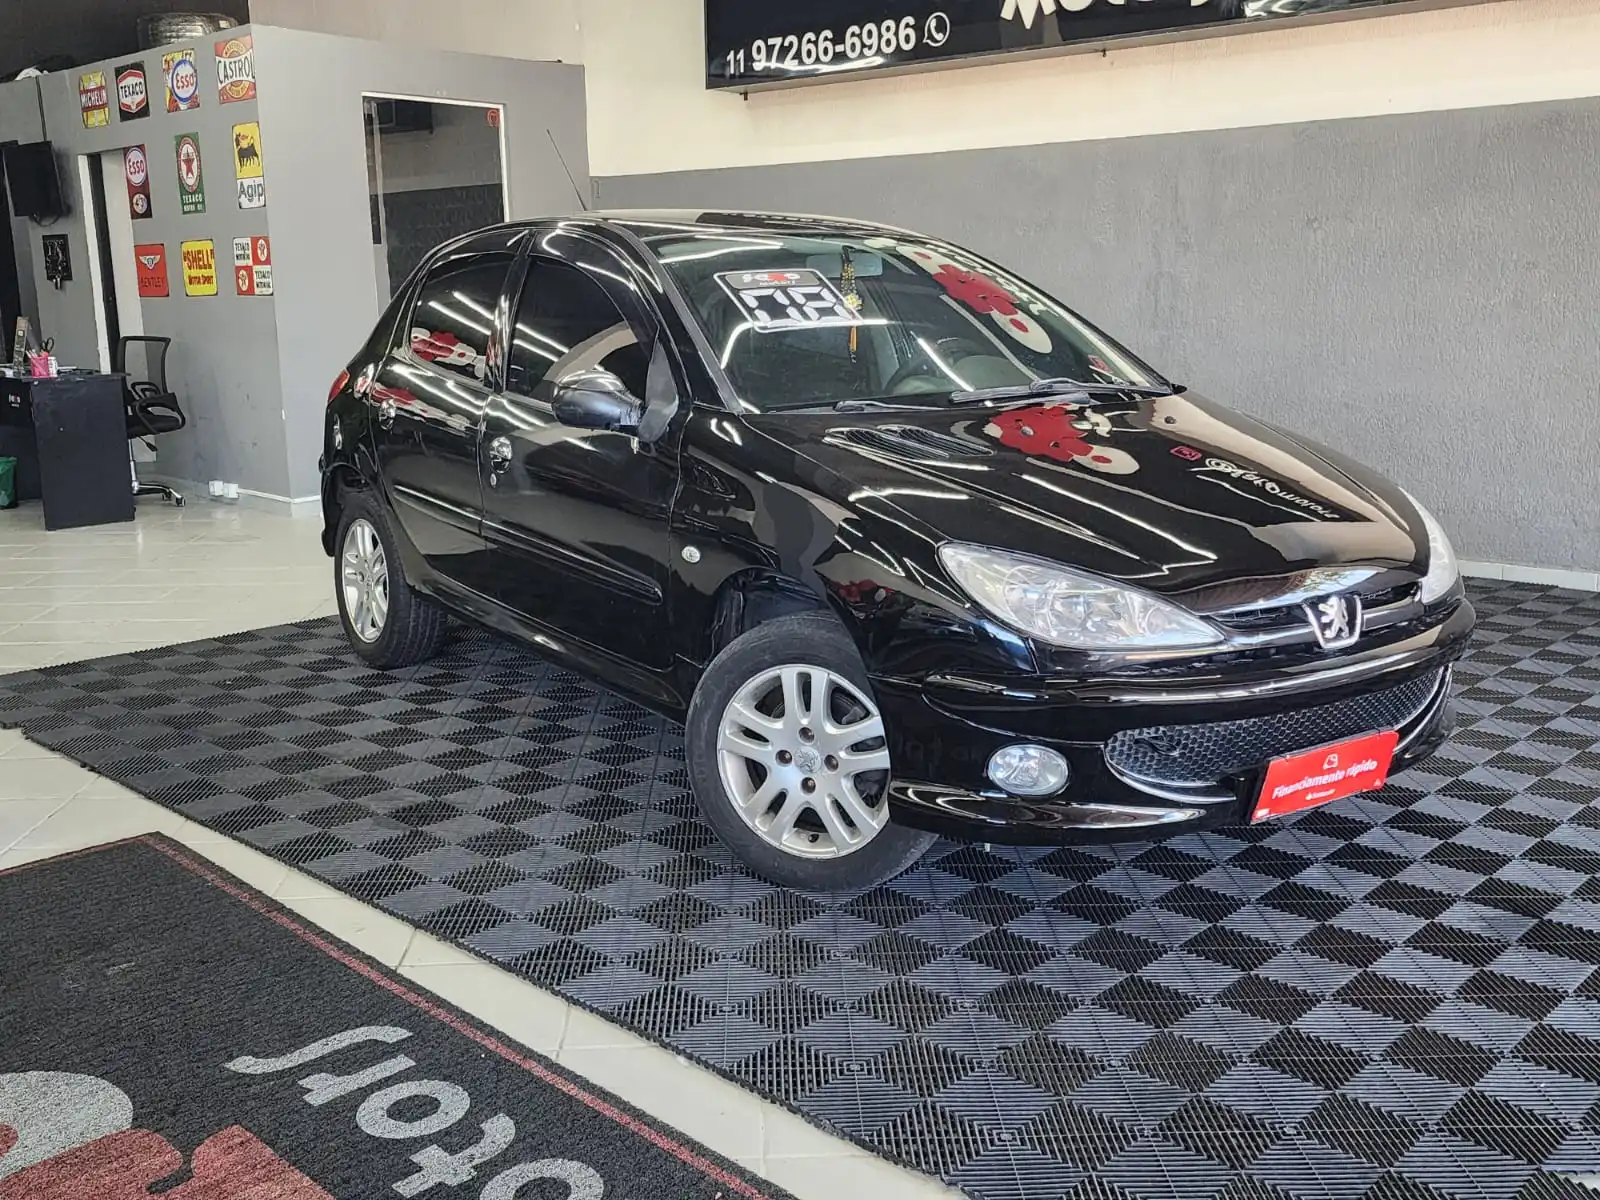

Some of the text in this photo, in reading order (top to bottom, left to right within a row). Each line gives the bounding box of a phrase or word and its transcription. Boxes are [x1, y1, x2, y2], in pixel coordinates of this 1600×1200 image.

[727, 19, 916, 75] 11 97266-6986
[217, 55, 256, 84] CASTROL
[80, 88, 107, 105] MICHELIN
[119, 81, 144, 100] TEXACO
[182, 194, 203, 204] TEXACO
[239, 180, 264, 203] Agip
[1272, 770, 1345, 800] Financiamento
[225, 1025, 604, 1200] otors
